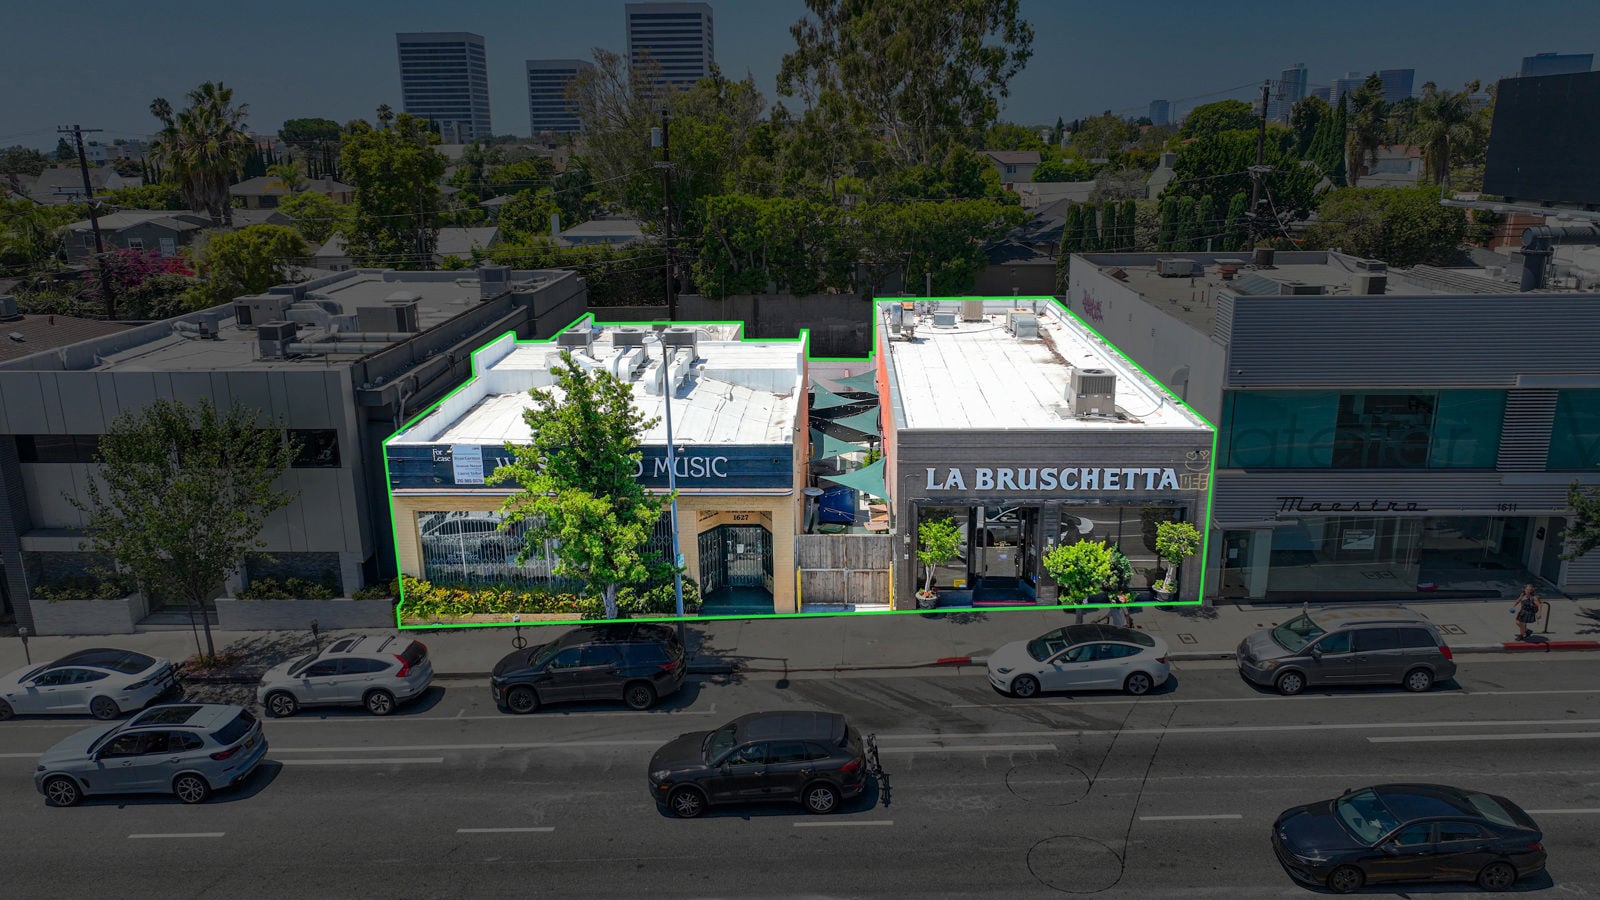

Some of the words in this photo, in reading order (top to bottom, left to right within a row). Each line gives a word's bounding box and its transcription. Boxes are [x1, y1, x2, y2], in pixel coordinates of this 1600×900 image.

[653, 456, 728, 478] MUSIC
[925, 467, 968, 491] LA
[975, 466, 1180, 491] BRUSCHETTA
[1276, 496, 1428, 512] Maestro
[1496, 503, 1517, 512] 1611
